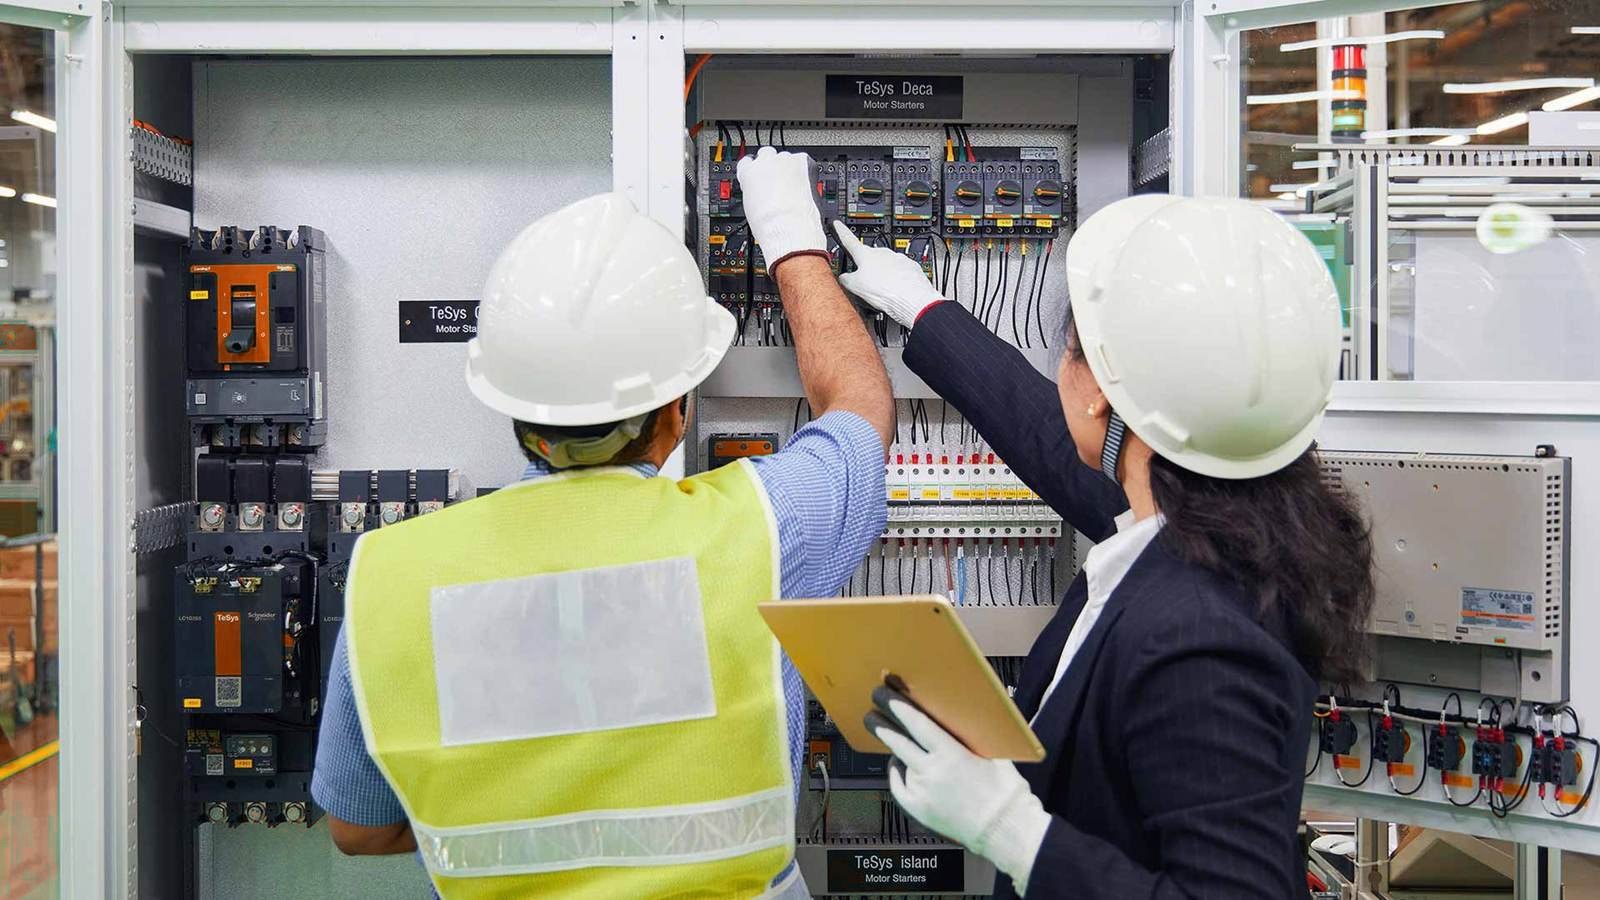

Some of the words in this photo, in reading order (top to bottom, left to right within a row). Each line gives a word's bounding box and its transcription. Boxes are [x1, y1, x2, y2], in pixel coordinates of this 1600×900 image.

[855, 80, 895, 97] TeSys
[902, 81, 934, 96] Deca
[863, 100, 889, 109] Motor
[890, 100, 925, 110] Starters
[428, 305, 468, 322] TeSys
[435, 325, 460, 333] Motor
[217, 614, 239, 623] TeSys
[855, 855, 893, 871] TeSys
[901, 855, 938, 869] island
[865, 873, 891, 882] Motor
[892, 873, 927, 883] Starters
